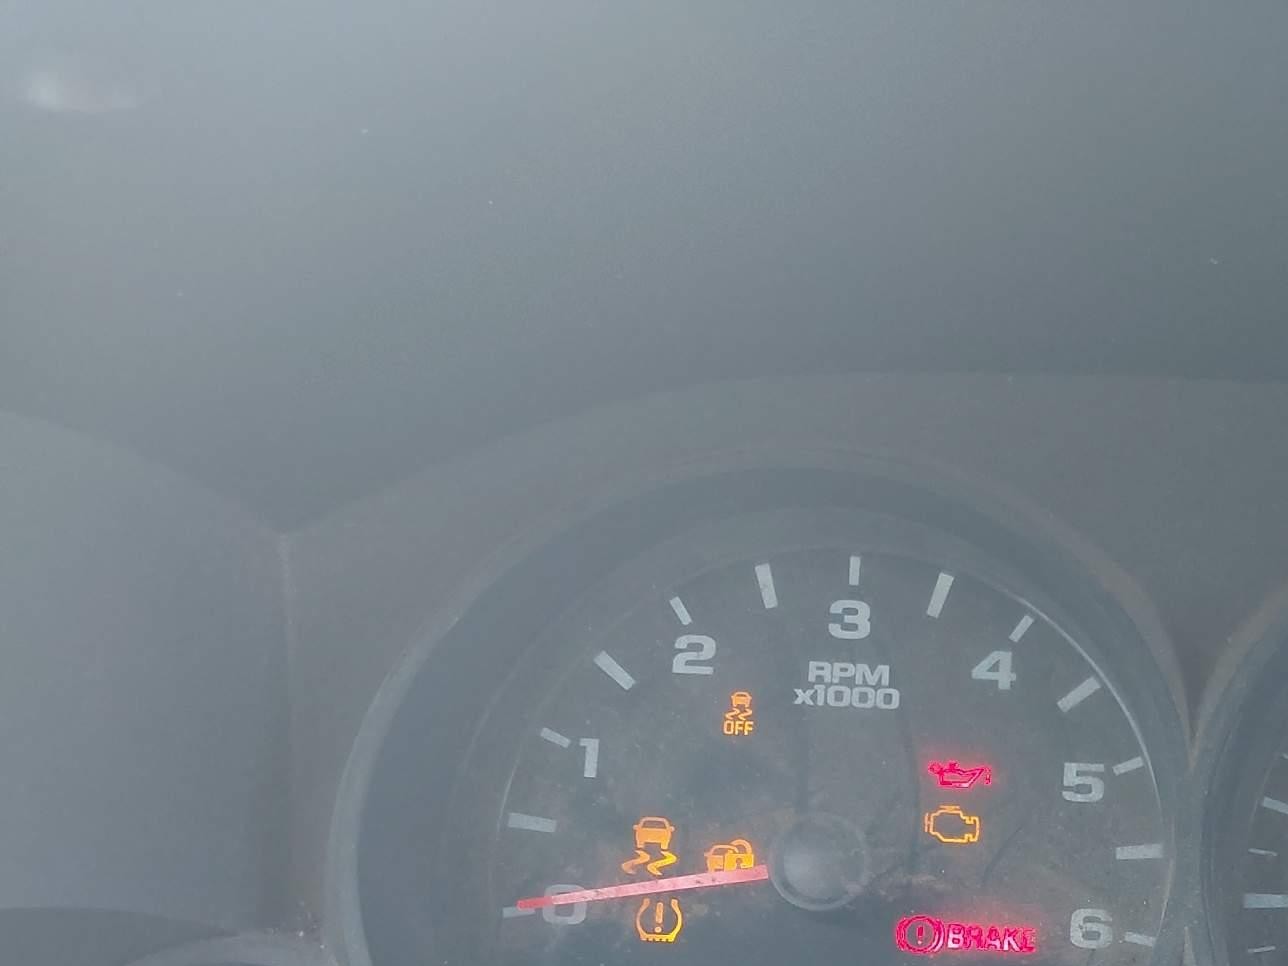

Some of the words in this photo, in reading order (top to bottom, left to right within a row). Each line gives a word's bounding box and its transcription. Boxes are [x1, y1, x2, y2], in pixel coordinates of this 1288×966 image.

[828, 600, 871, 640] 3
[672, 634, 717, 675] 2
[807, 661, 890, 686] RPM
[971, 650, 1017, 690] 4
[793, 685, 900, 709] x1000
[723, 720, 754, 736] OFF
[579, 738, 600, 778] 1
[1061, 762, 1105, 804] 5
[947, 923, 1037, 953] BRAKE
[1070, 908, 1113, 949] 6
